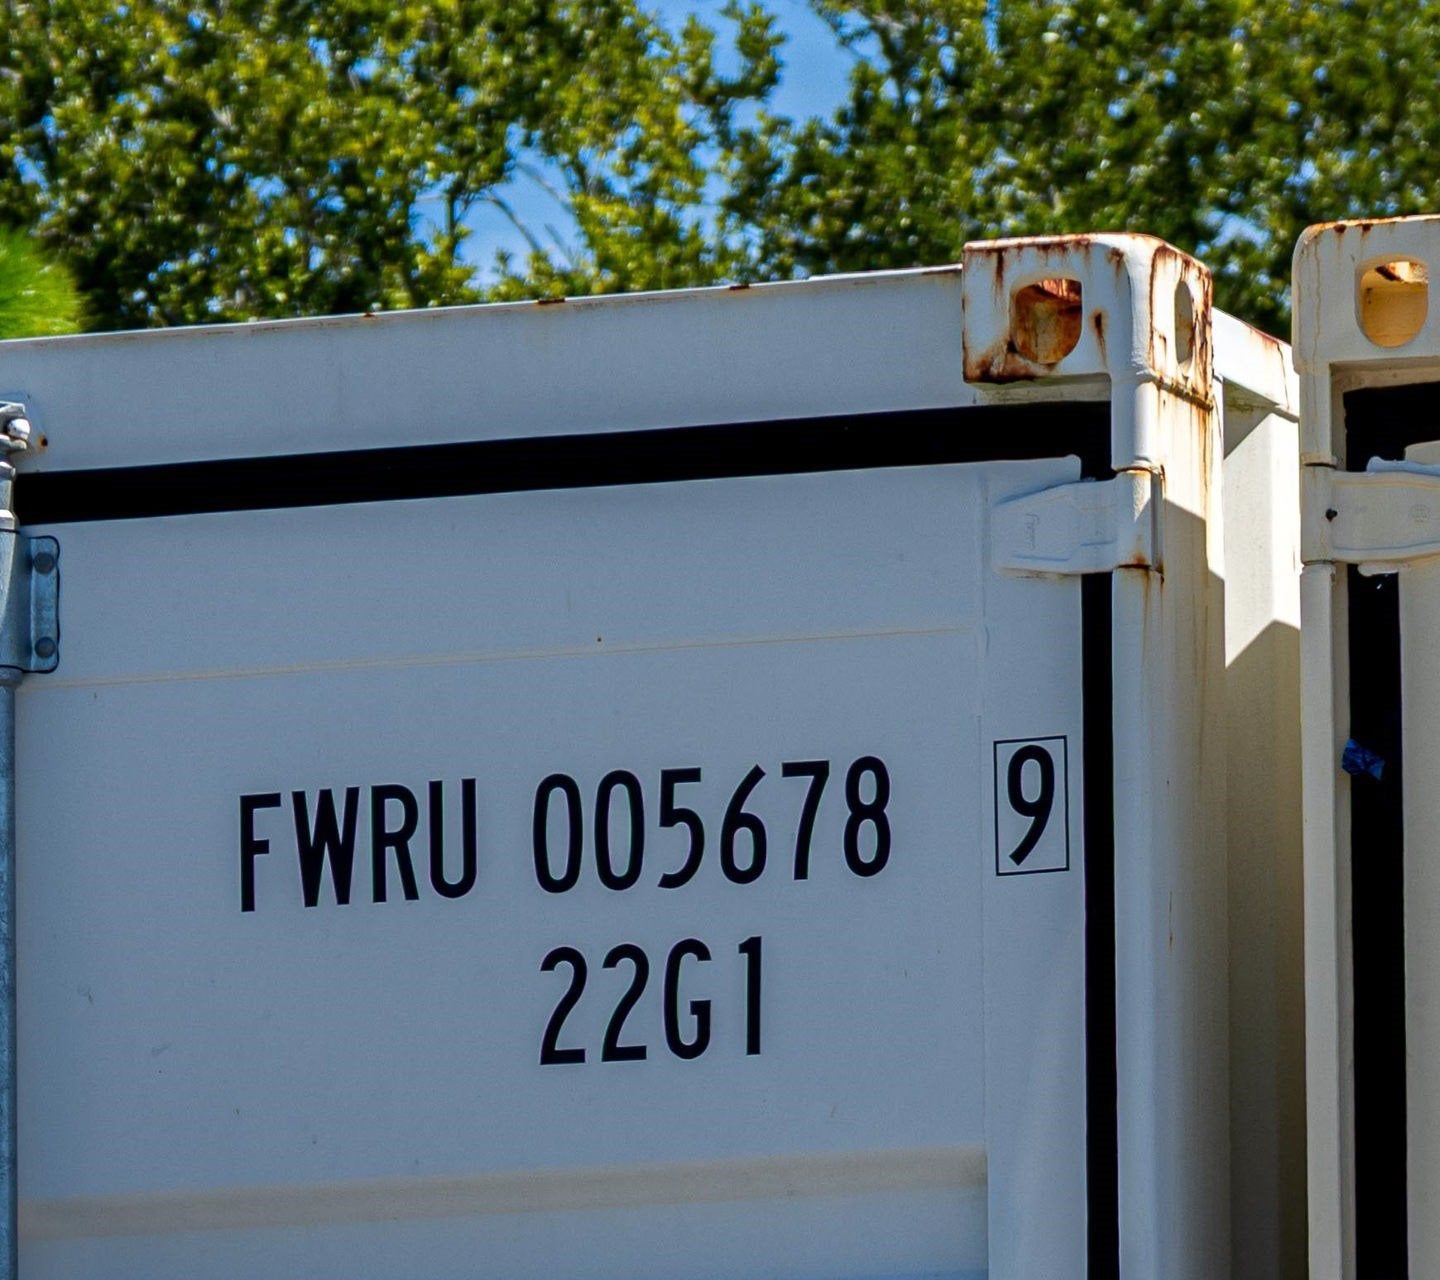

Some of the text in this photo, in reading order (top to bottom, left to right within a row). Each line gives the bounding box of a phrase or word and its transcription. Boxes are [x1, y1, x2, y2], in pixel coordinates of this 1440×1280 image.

[239, 743, 1057, 913] FWRU 005678 9
[539, 935, 762, 1066] 22G1
